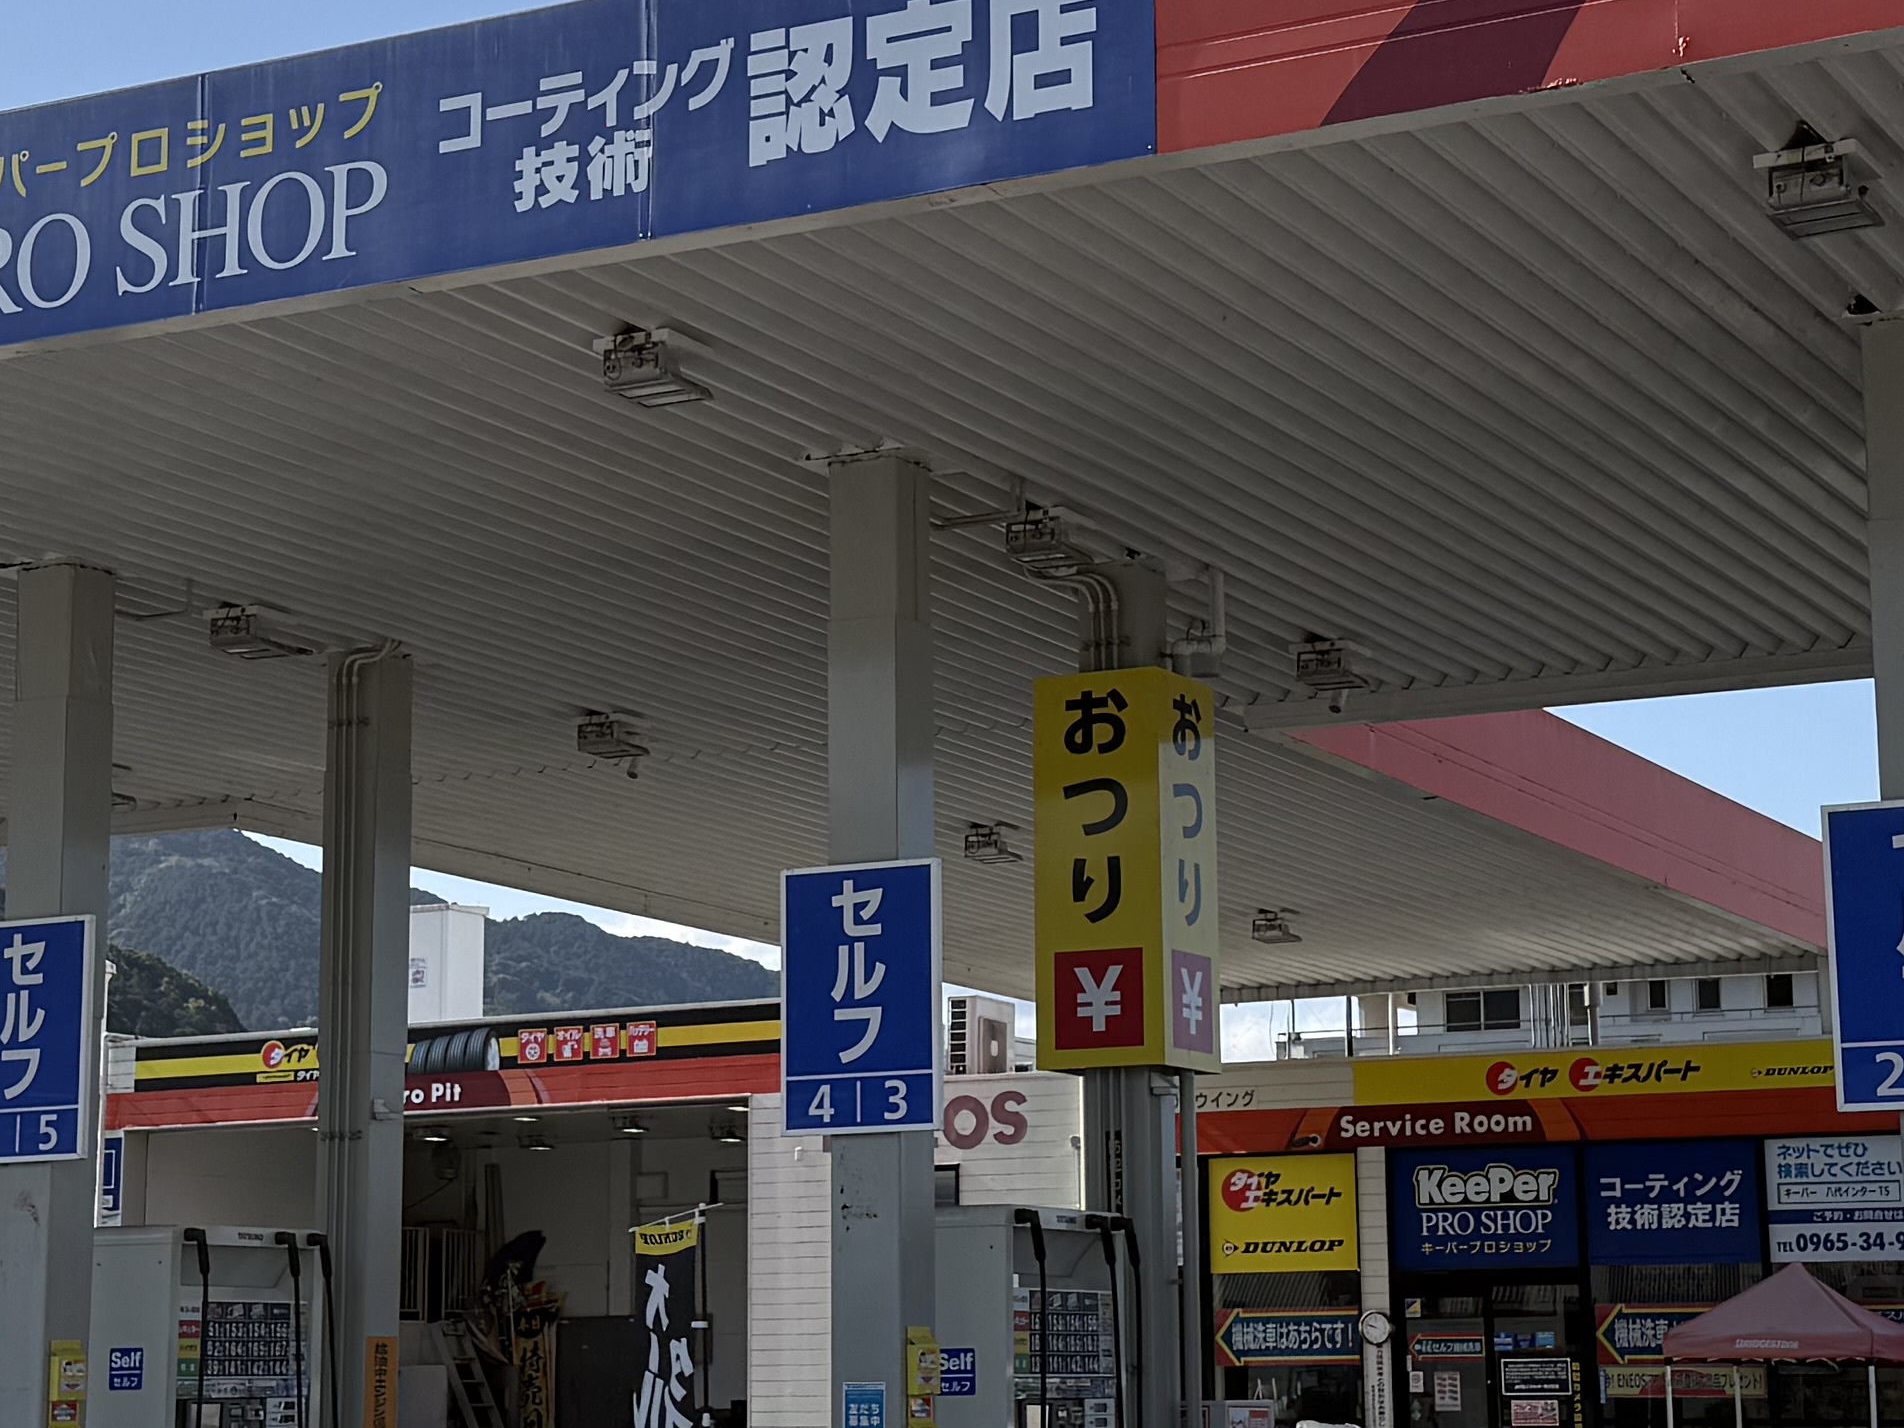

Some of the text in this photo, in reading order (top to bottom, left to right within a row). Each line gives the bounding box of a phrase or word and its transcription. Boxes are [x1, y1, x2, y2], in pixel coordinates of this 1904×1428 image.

[438, 37, 734, 153] コーティング
[513, 127, 650, 212] 技術
[116, 160, 388, 297] SHOP
[1063, 688, 1128, 924] おつり
[1172, 692, 1203, 927] おつり
[831, 879, 886, 1064] セルフ
[0, 933, 46, 1100] セルフ
[1764, 1065, 1834, 1077] DUNLOP
[431, 1083, 462, 1103] Pit
[808, 1080, 909, 1124] 4 3
[38, 1113, 59, 1151] 5
[1339, 1110, 1532, 1139] Service Room
[1777, 1142, 1868, 1160] ネットでぜひ
[1416, 1166, 1556, 1205] KeePer
[1599, 1169, 1743, 1199] コーティング
[1420, 1209, 1553, 1236] PRO SHOP
[1606, 1201, 1741, 1231] 技術認定店
[1241, 1239, 1345, 1254] DUNLOP
[1777, 1241, 1794, 1253] TEL
[1613, 1318, 1670, 1349] 機械洗車
[110, 1351, 142, 1369] Self
[939, 1352, 974, 1371] Self
[113, 1376, 139, 1388] セルフ
[940, 1380, 971, 1392] セルフ
